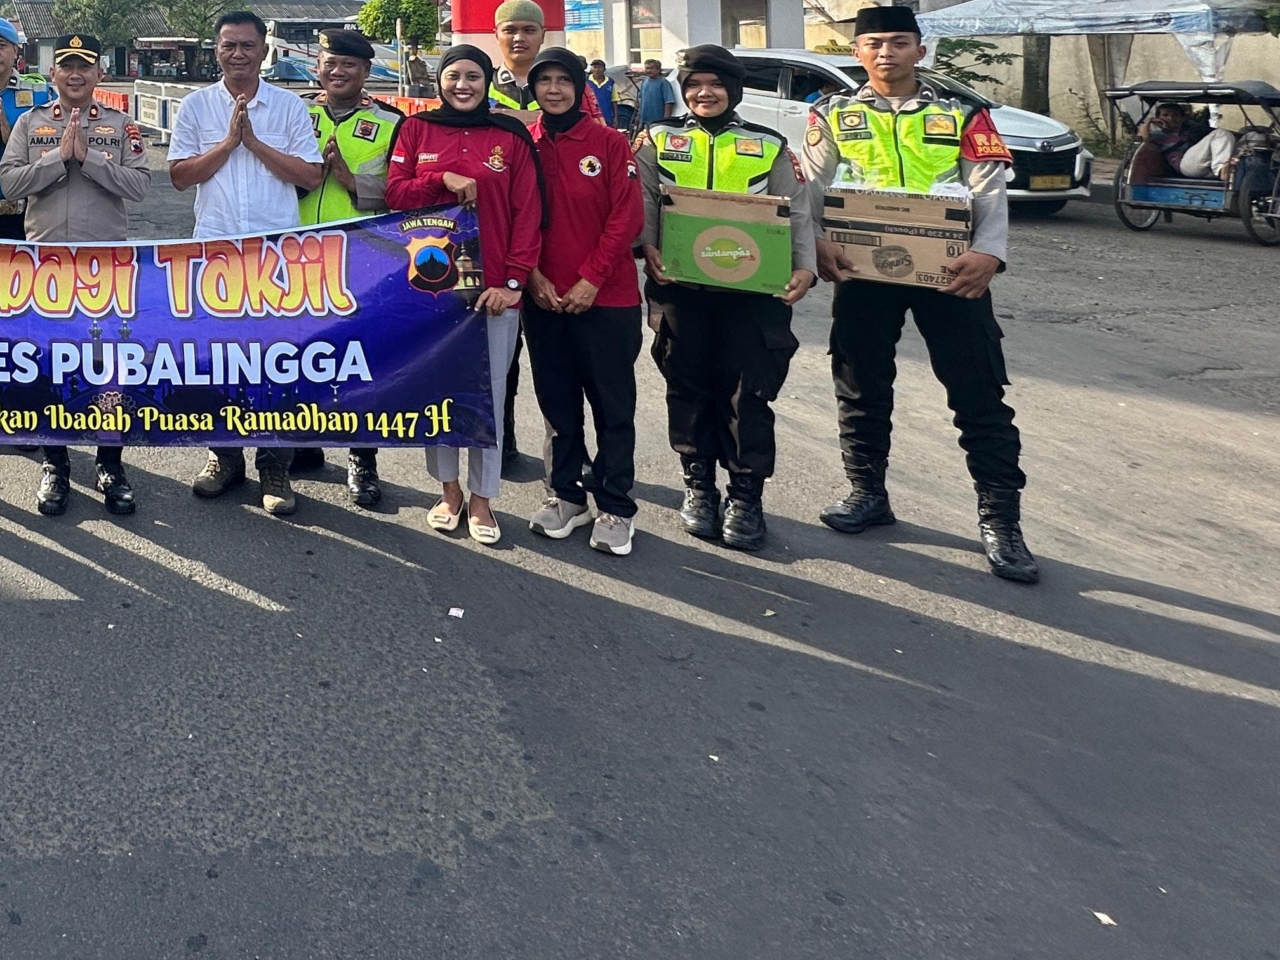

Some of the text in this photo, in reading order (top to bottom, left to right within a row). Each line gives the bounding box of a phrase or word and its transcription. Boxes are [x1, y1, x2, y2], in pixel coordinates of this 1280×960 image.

[88, 136, 120, 147] POLRI
[402, 218, 455, 231] JAWA TENGAH
[947, 245, 961, 256] 10
[155, 229, 357, 315] Takjil
[52, 340, 373, 386] PUBALINGGA
[43, 403, 132, 433] Ibadah
[137, 406, 214, 433] Puasa
[220, 402, 359, 437] Ramadhan
[364, 411, 420, 438] 1447
[424, 398, 454, 437] H
